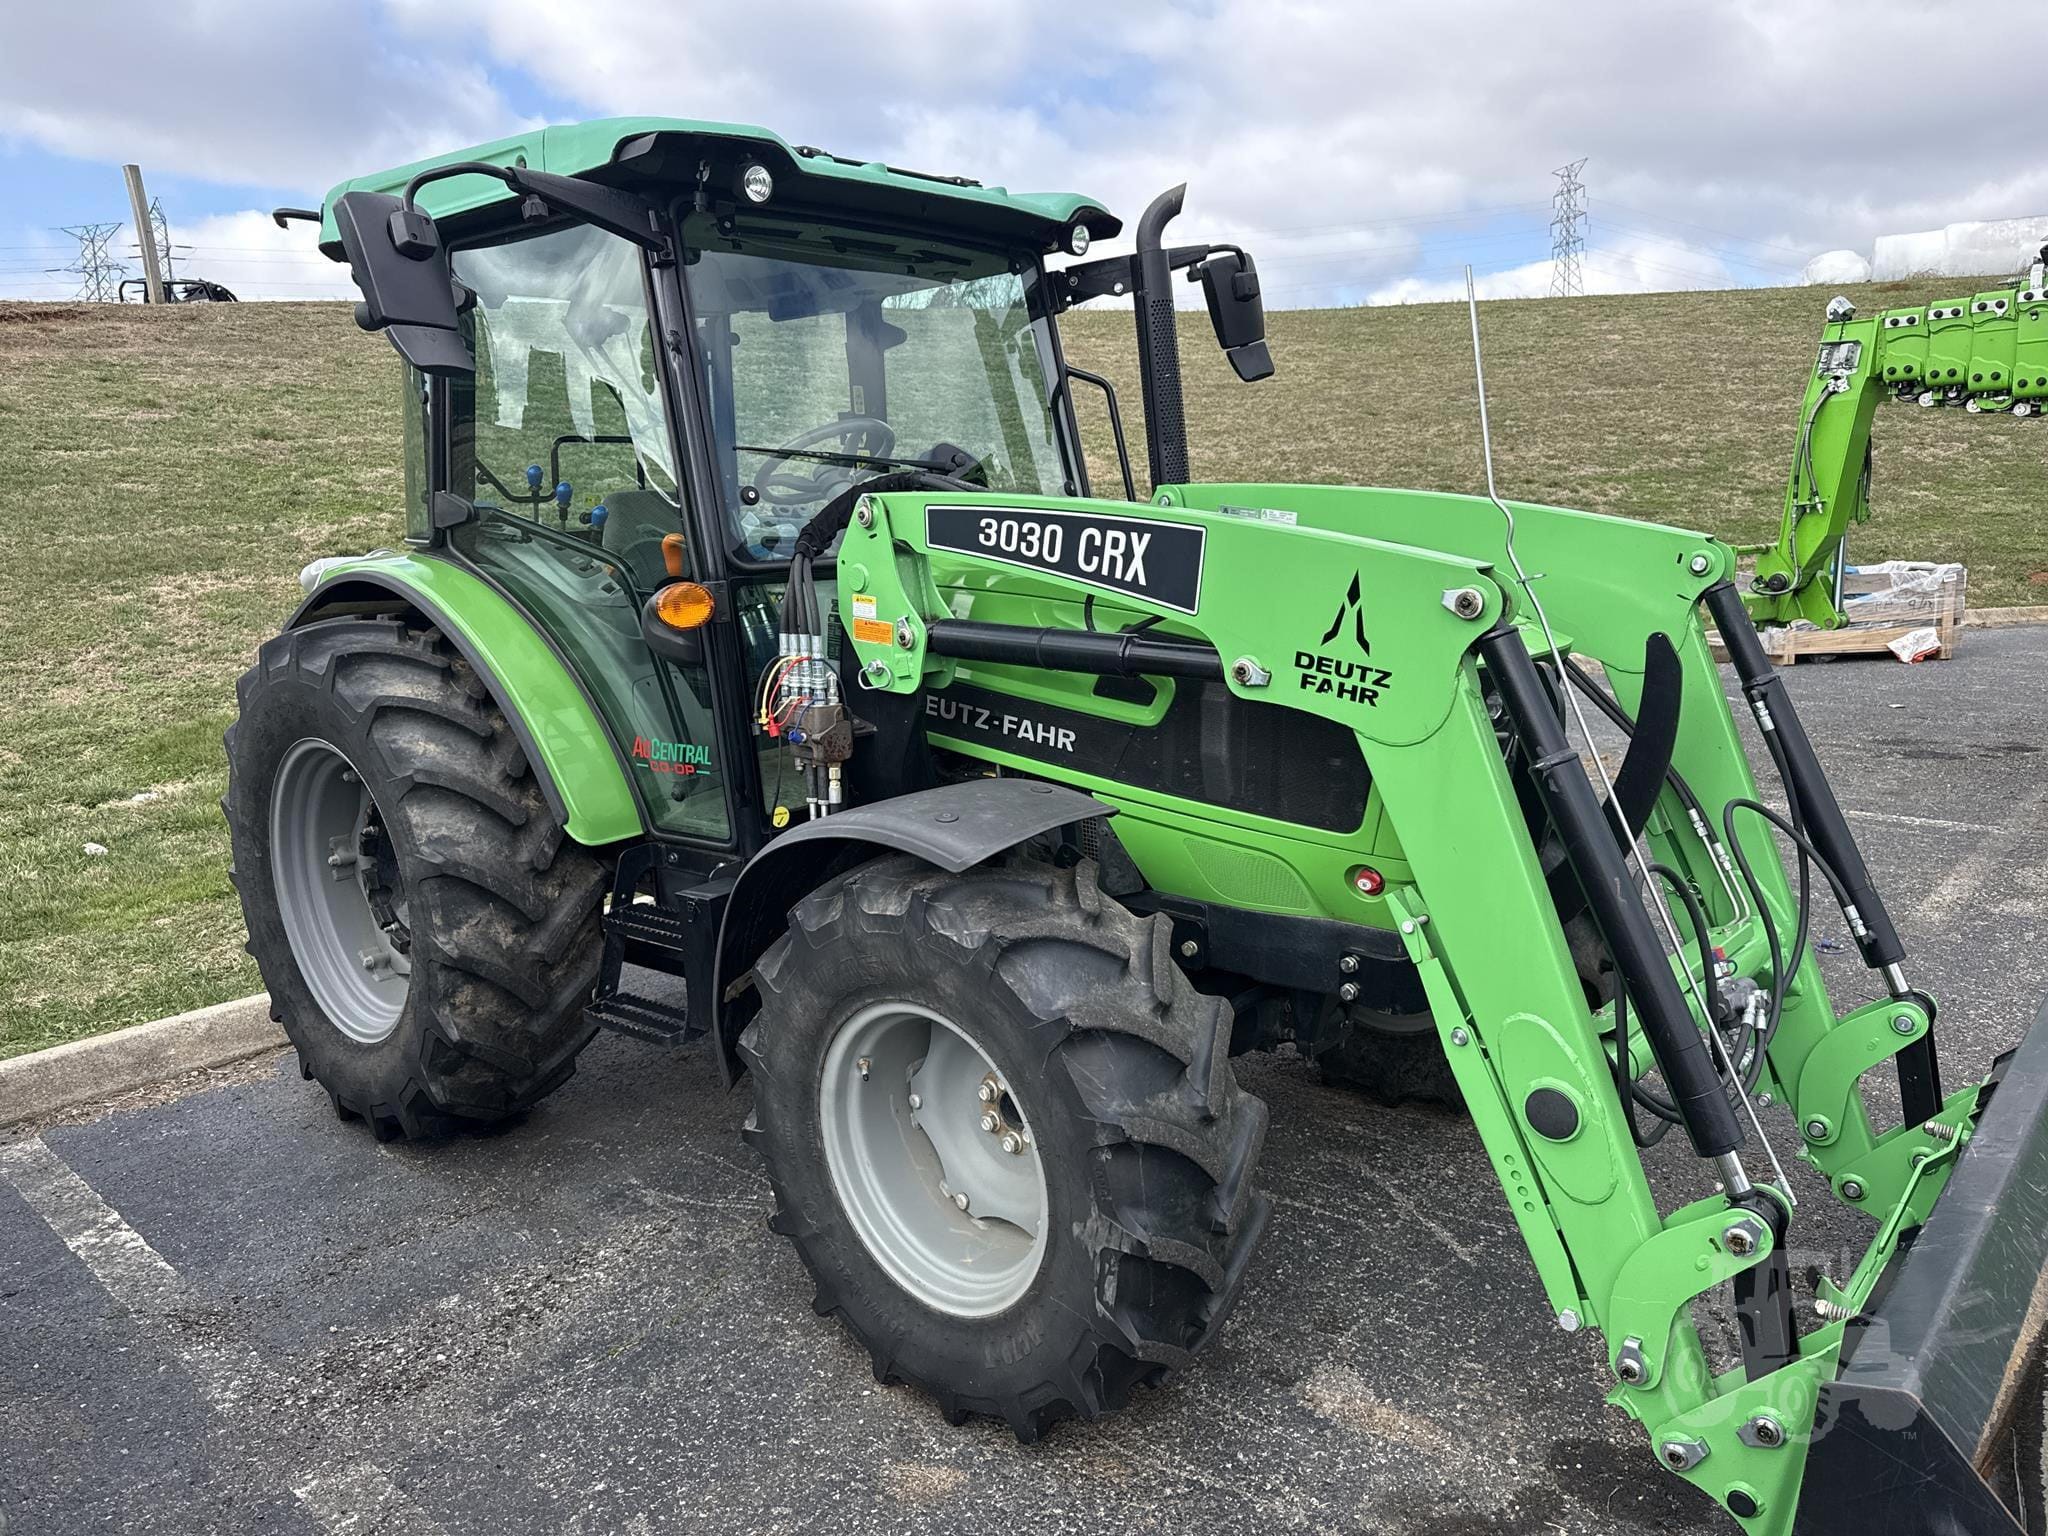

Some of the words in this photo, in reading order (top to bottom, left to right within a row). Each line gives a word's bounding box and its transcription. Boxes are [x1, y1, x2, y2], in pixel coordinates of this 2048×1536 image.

[978, 518, 1063, 563] 3030
[1077, 527, 1151, 586] CRX
[1294, 651, 1393, 689] DEUTZ
[1300, 673, 1379, 707] FAHR
[925, 694, 1076, 752] EUTZ-FAHR
[649, 761, 695, 775] CO-OP
